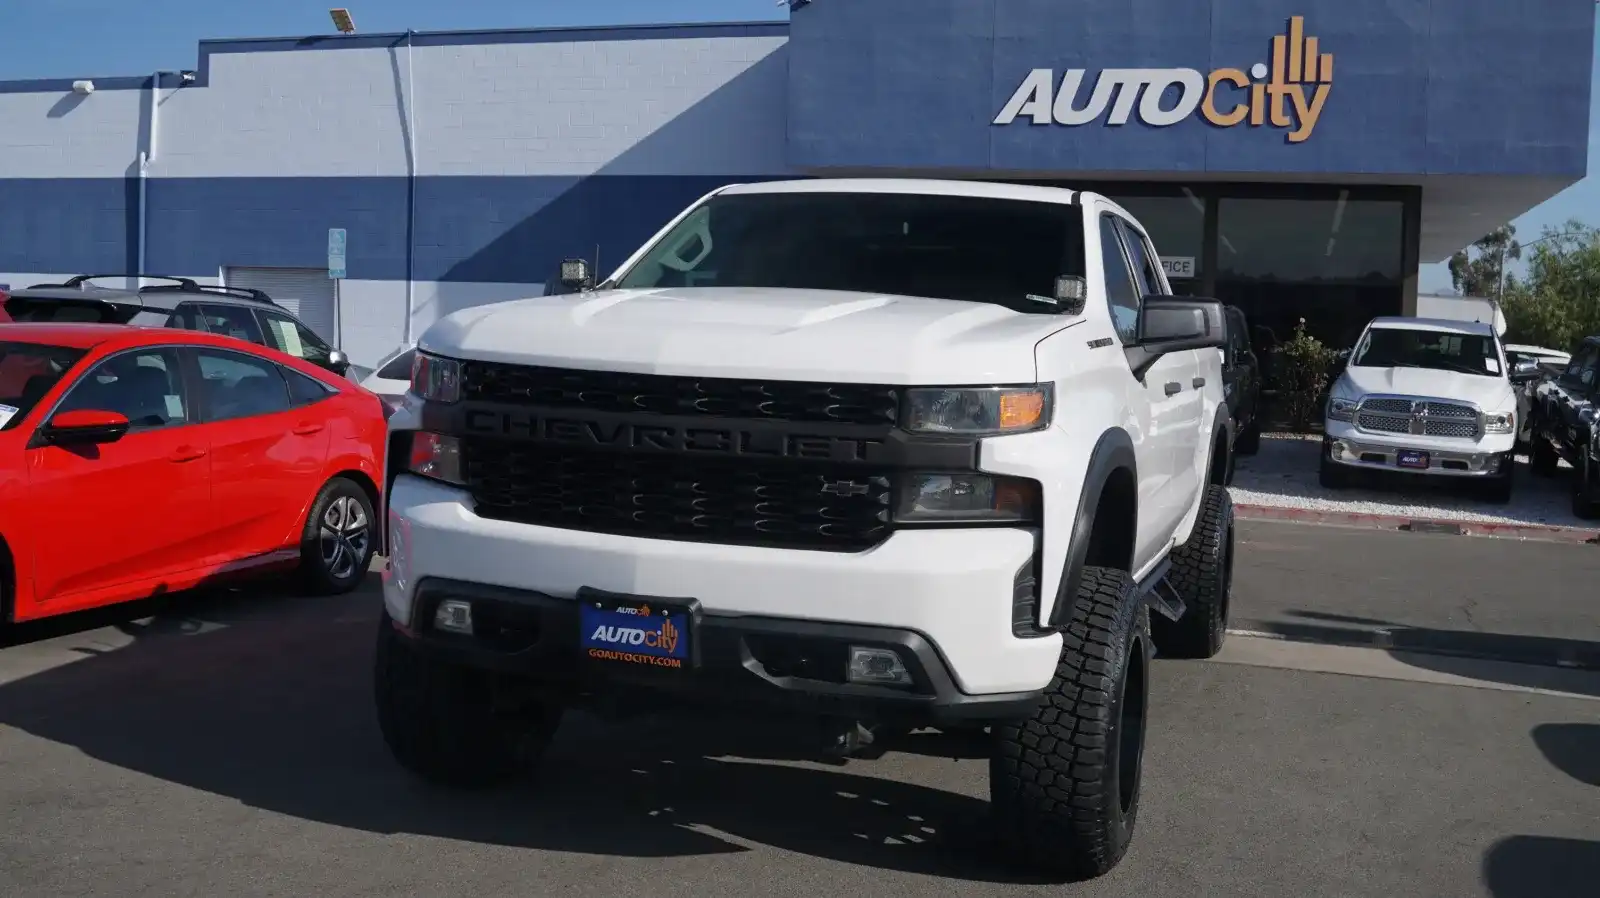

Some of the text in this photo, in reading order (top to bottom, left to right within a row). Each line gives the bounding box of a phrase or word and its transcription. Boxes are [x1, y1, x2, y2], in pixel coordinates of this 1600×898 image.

[1161, 260, 1191, 273] FICE
[465, 409, 886, 461] CHEVROLET
[588, 648, 681, 668] GOAUTOCITY.COM
